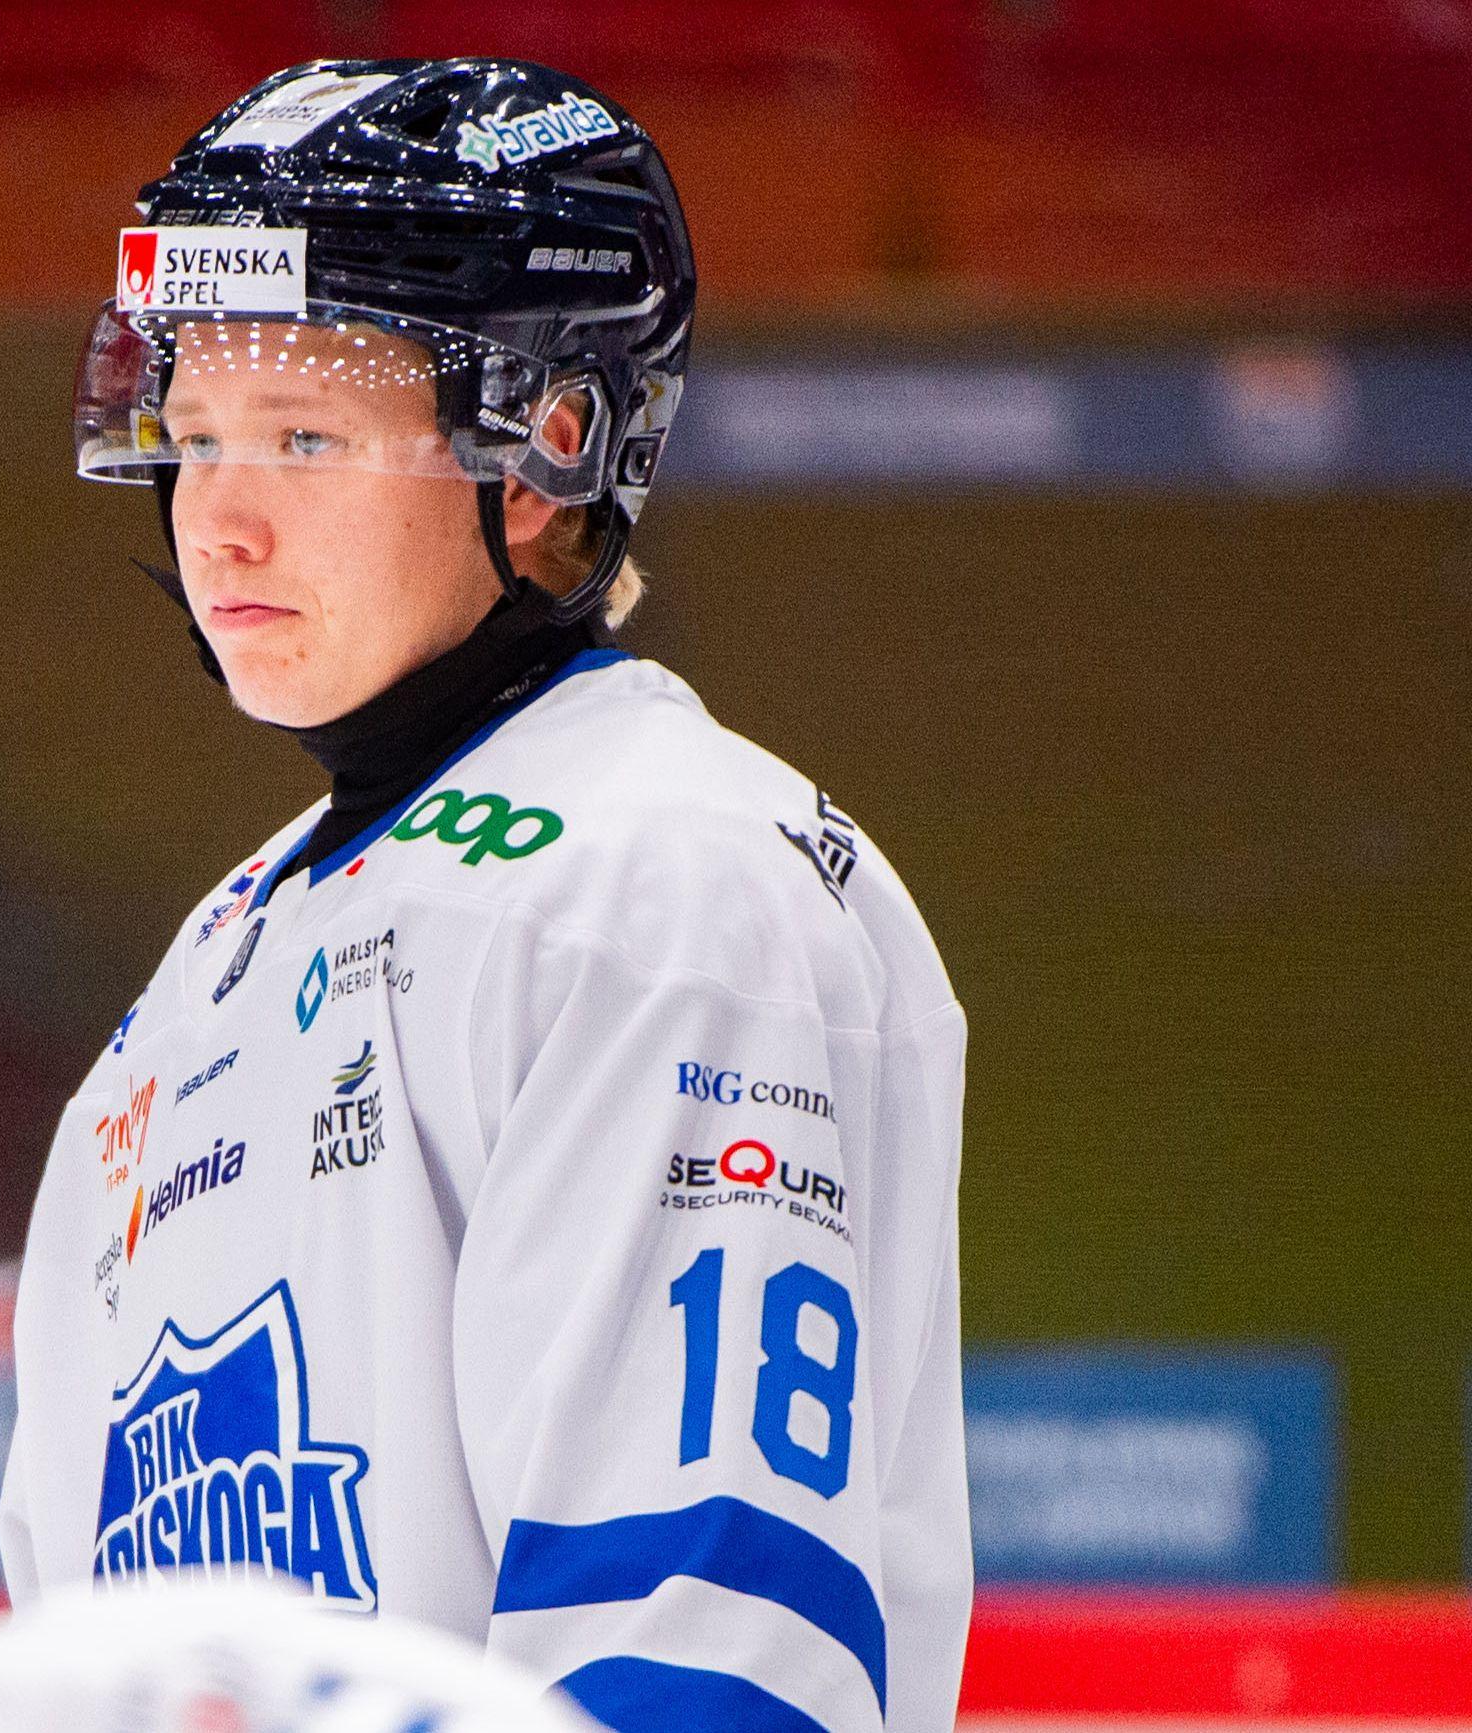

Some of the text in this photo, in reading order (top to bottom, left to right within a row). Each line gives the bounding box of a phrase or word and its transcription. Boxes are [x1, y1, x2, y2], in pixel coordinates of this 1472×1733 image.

[497, 96, 614, 161] bravida
[165, 248, 294, 275] SVENSKA
[528, 247, 631, 273] BAUER
[163, 281, 224, 304] SPEL
[676, 1061, 743, 1105] RSG
[143, 1138, 246, 1238] Helmia
[672, 1190, 783, 1210] SECURITY
[670, 1247, 858, 1501] 18
[131, 1400, 196, 1494] BIK
